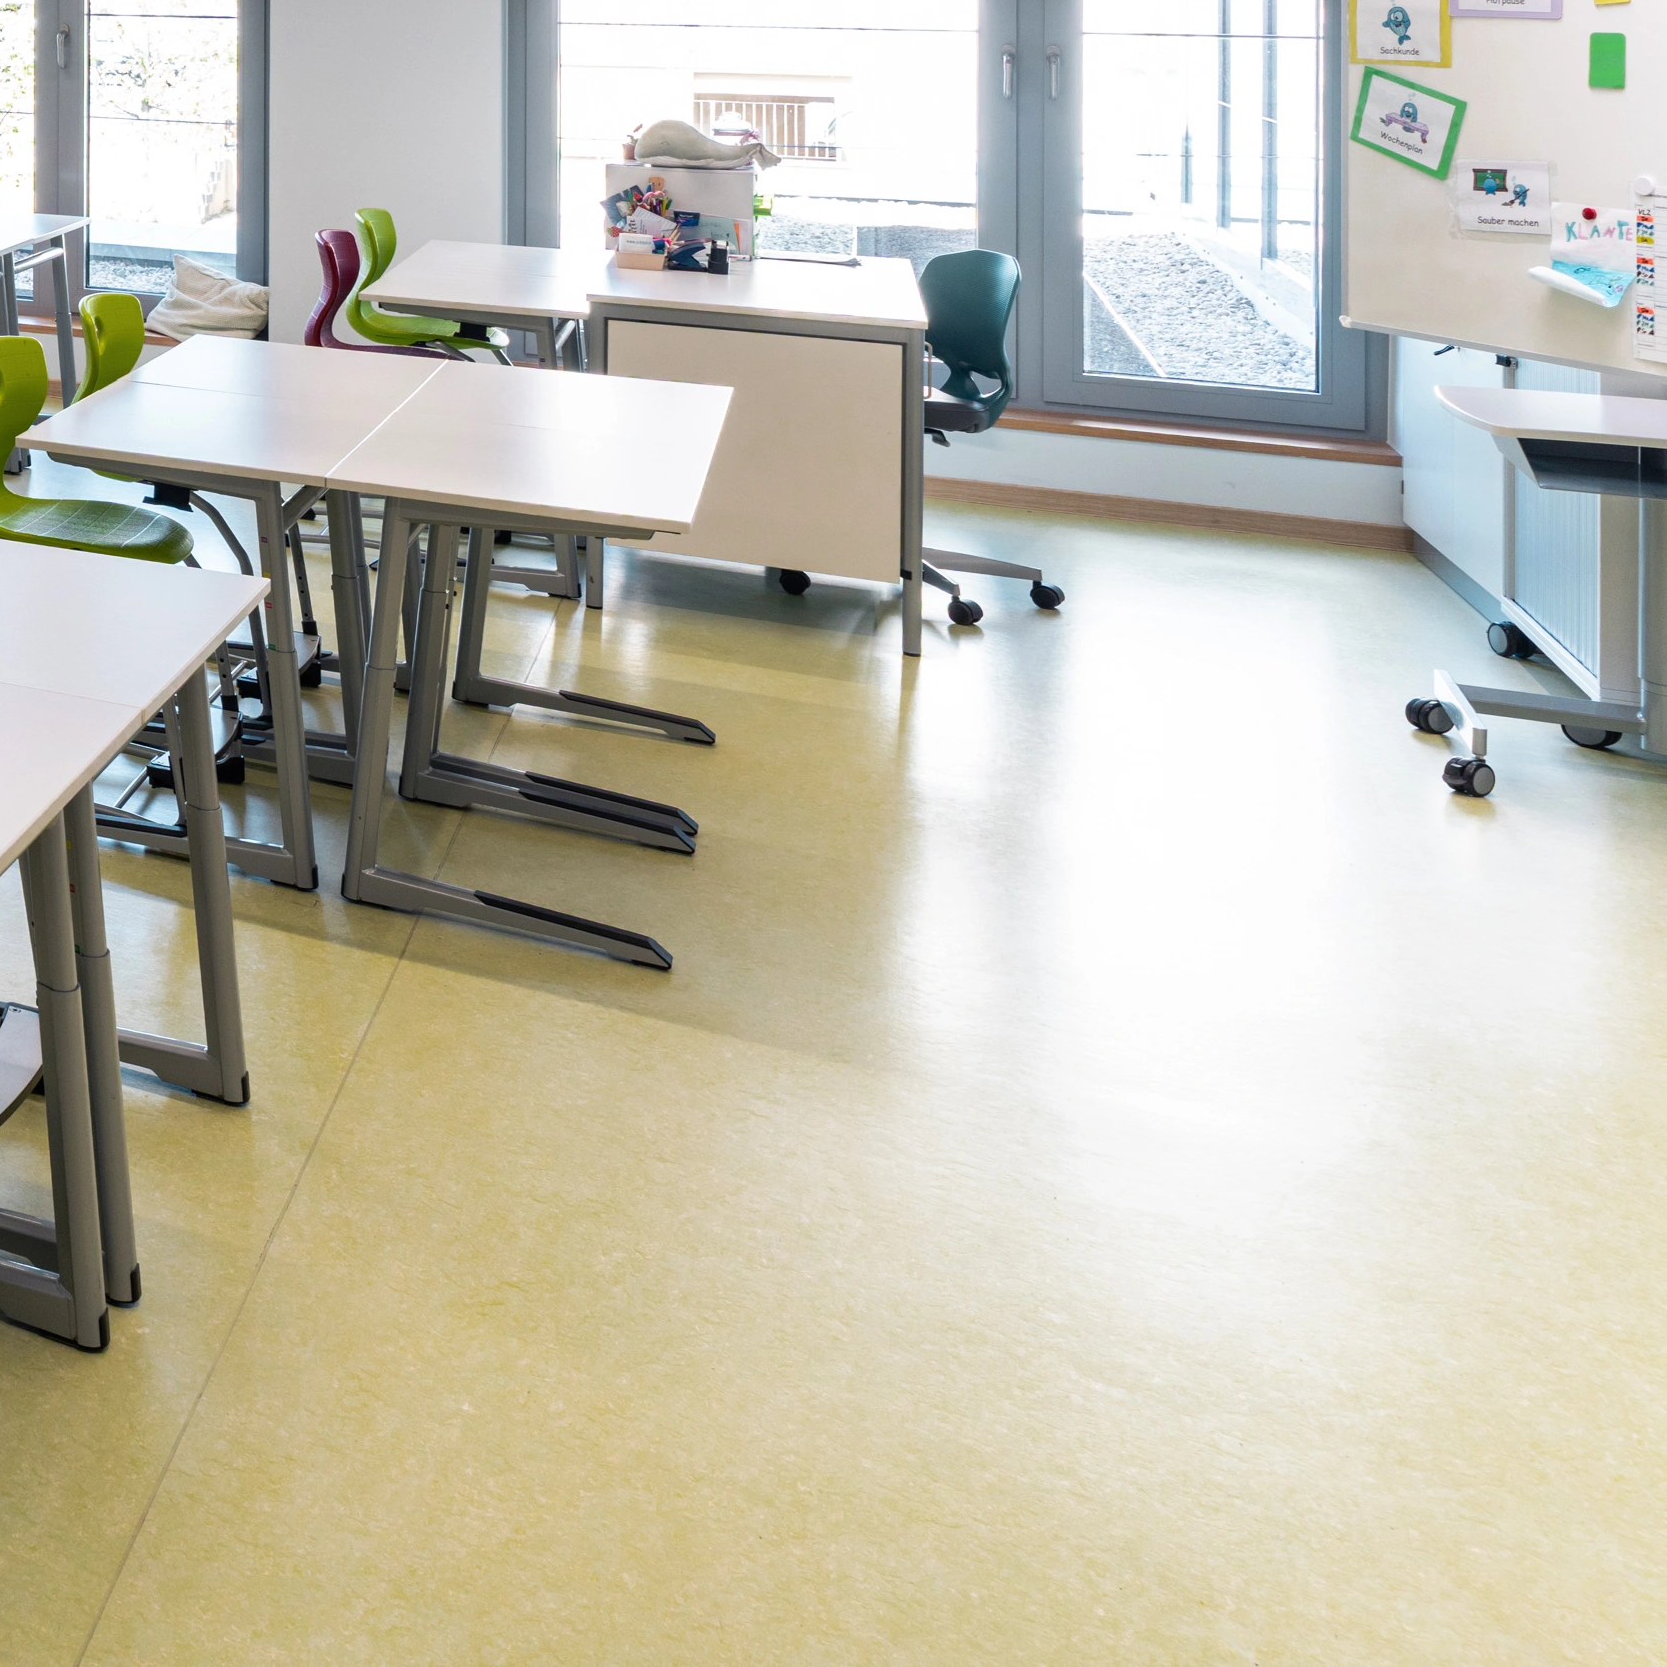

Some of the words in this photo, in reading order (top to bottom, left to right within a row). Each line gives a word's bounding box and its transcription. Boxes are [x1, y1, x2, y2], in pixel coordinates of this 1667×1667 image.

[1380, 47, 1420, 56] Sachkunde
[1380, 131, 1423, 155] Wochenplan
[1477, 216, 1506, 225] Sauber
[1507, 218, 1539, 227] machen
